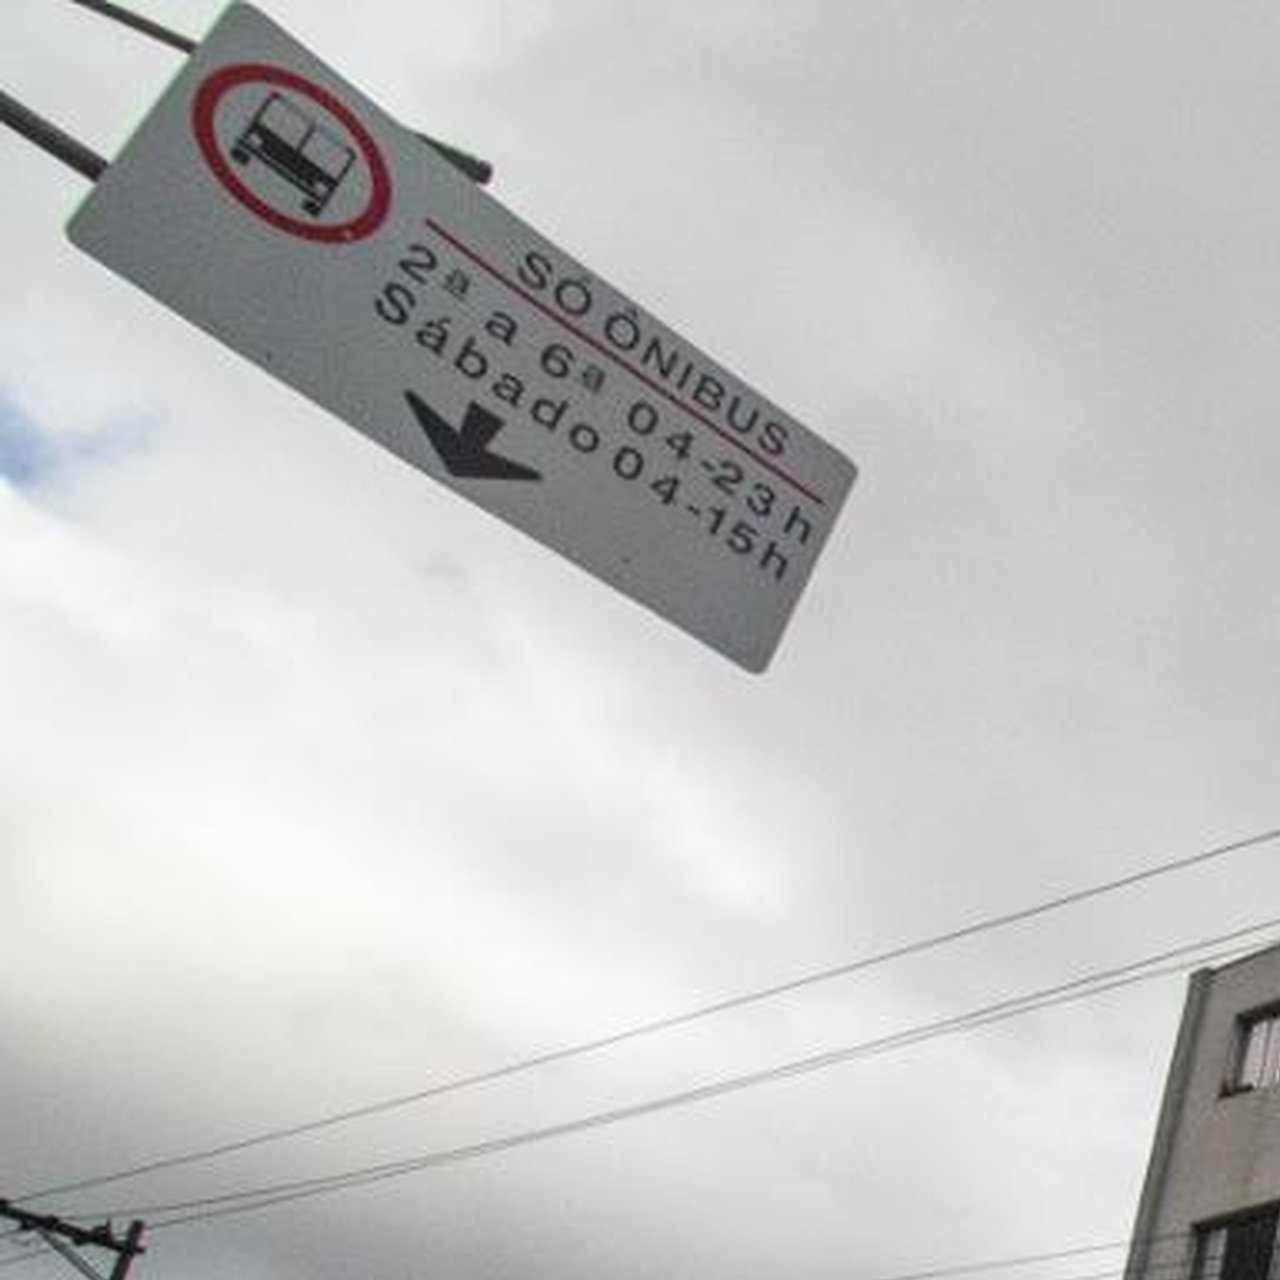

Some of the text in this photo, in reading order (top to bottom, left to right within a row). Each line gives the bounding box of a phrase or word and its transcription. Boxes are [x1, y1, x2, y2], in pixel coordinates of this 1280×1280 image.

[376, 282, 599, 453] Sábado
[485, 311, 518, 346] a
[518, 252, 789, 457] SÓ ÔNIBUS
